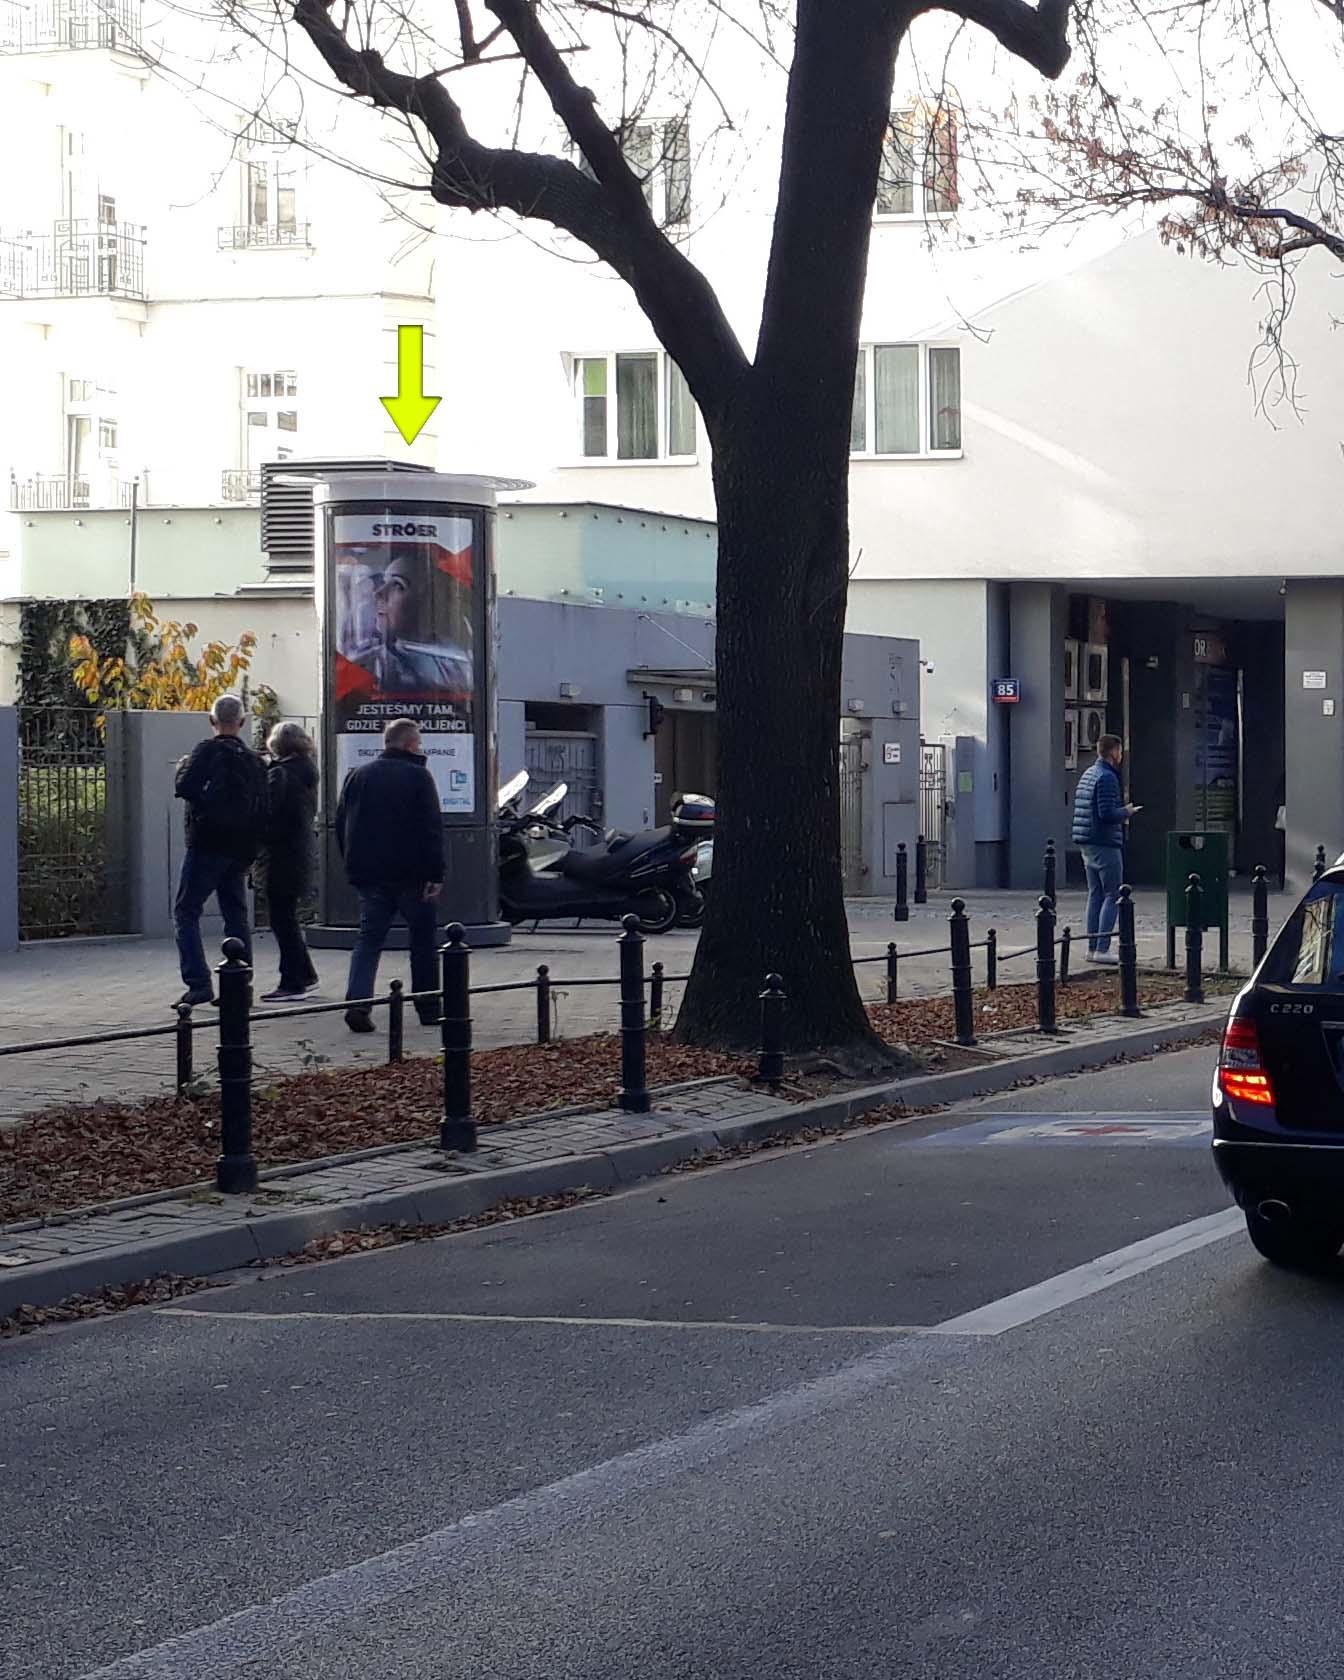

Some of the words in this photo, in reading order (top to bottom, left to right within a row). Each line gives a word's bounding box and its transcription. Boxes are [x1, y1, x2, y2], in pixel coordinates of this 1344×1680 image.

[998, 684, 1014, 696] 85
[357, 703, 423, 715] JESTEŚMY
[347, 720, 380, 731] GDZIE
[420, 719, 466, 731] KLIENCI
